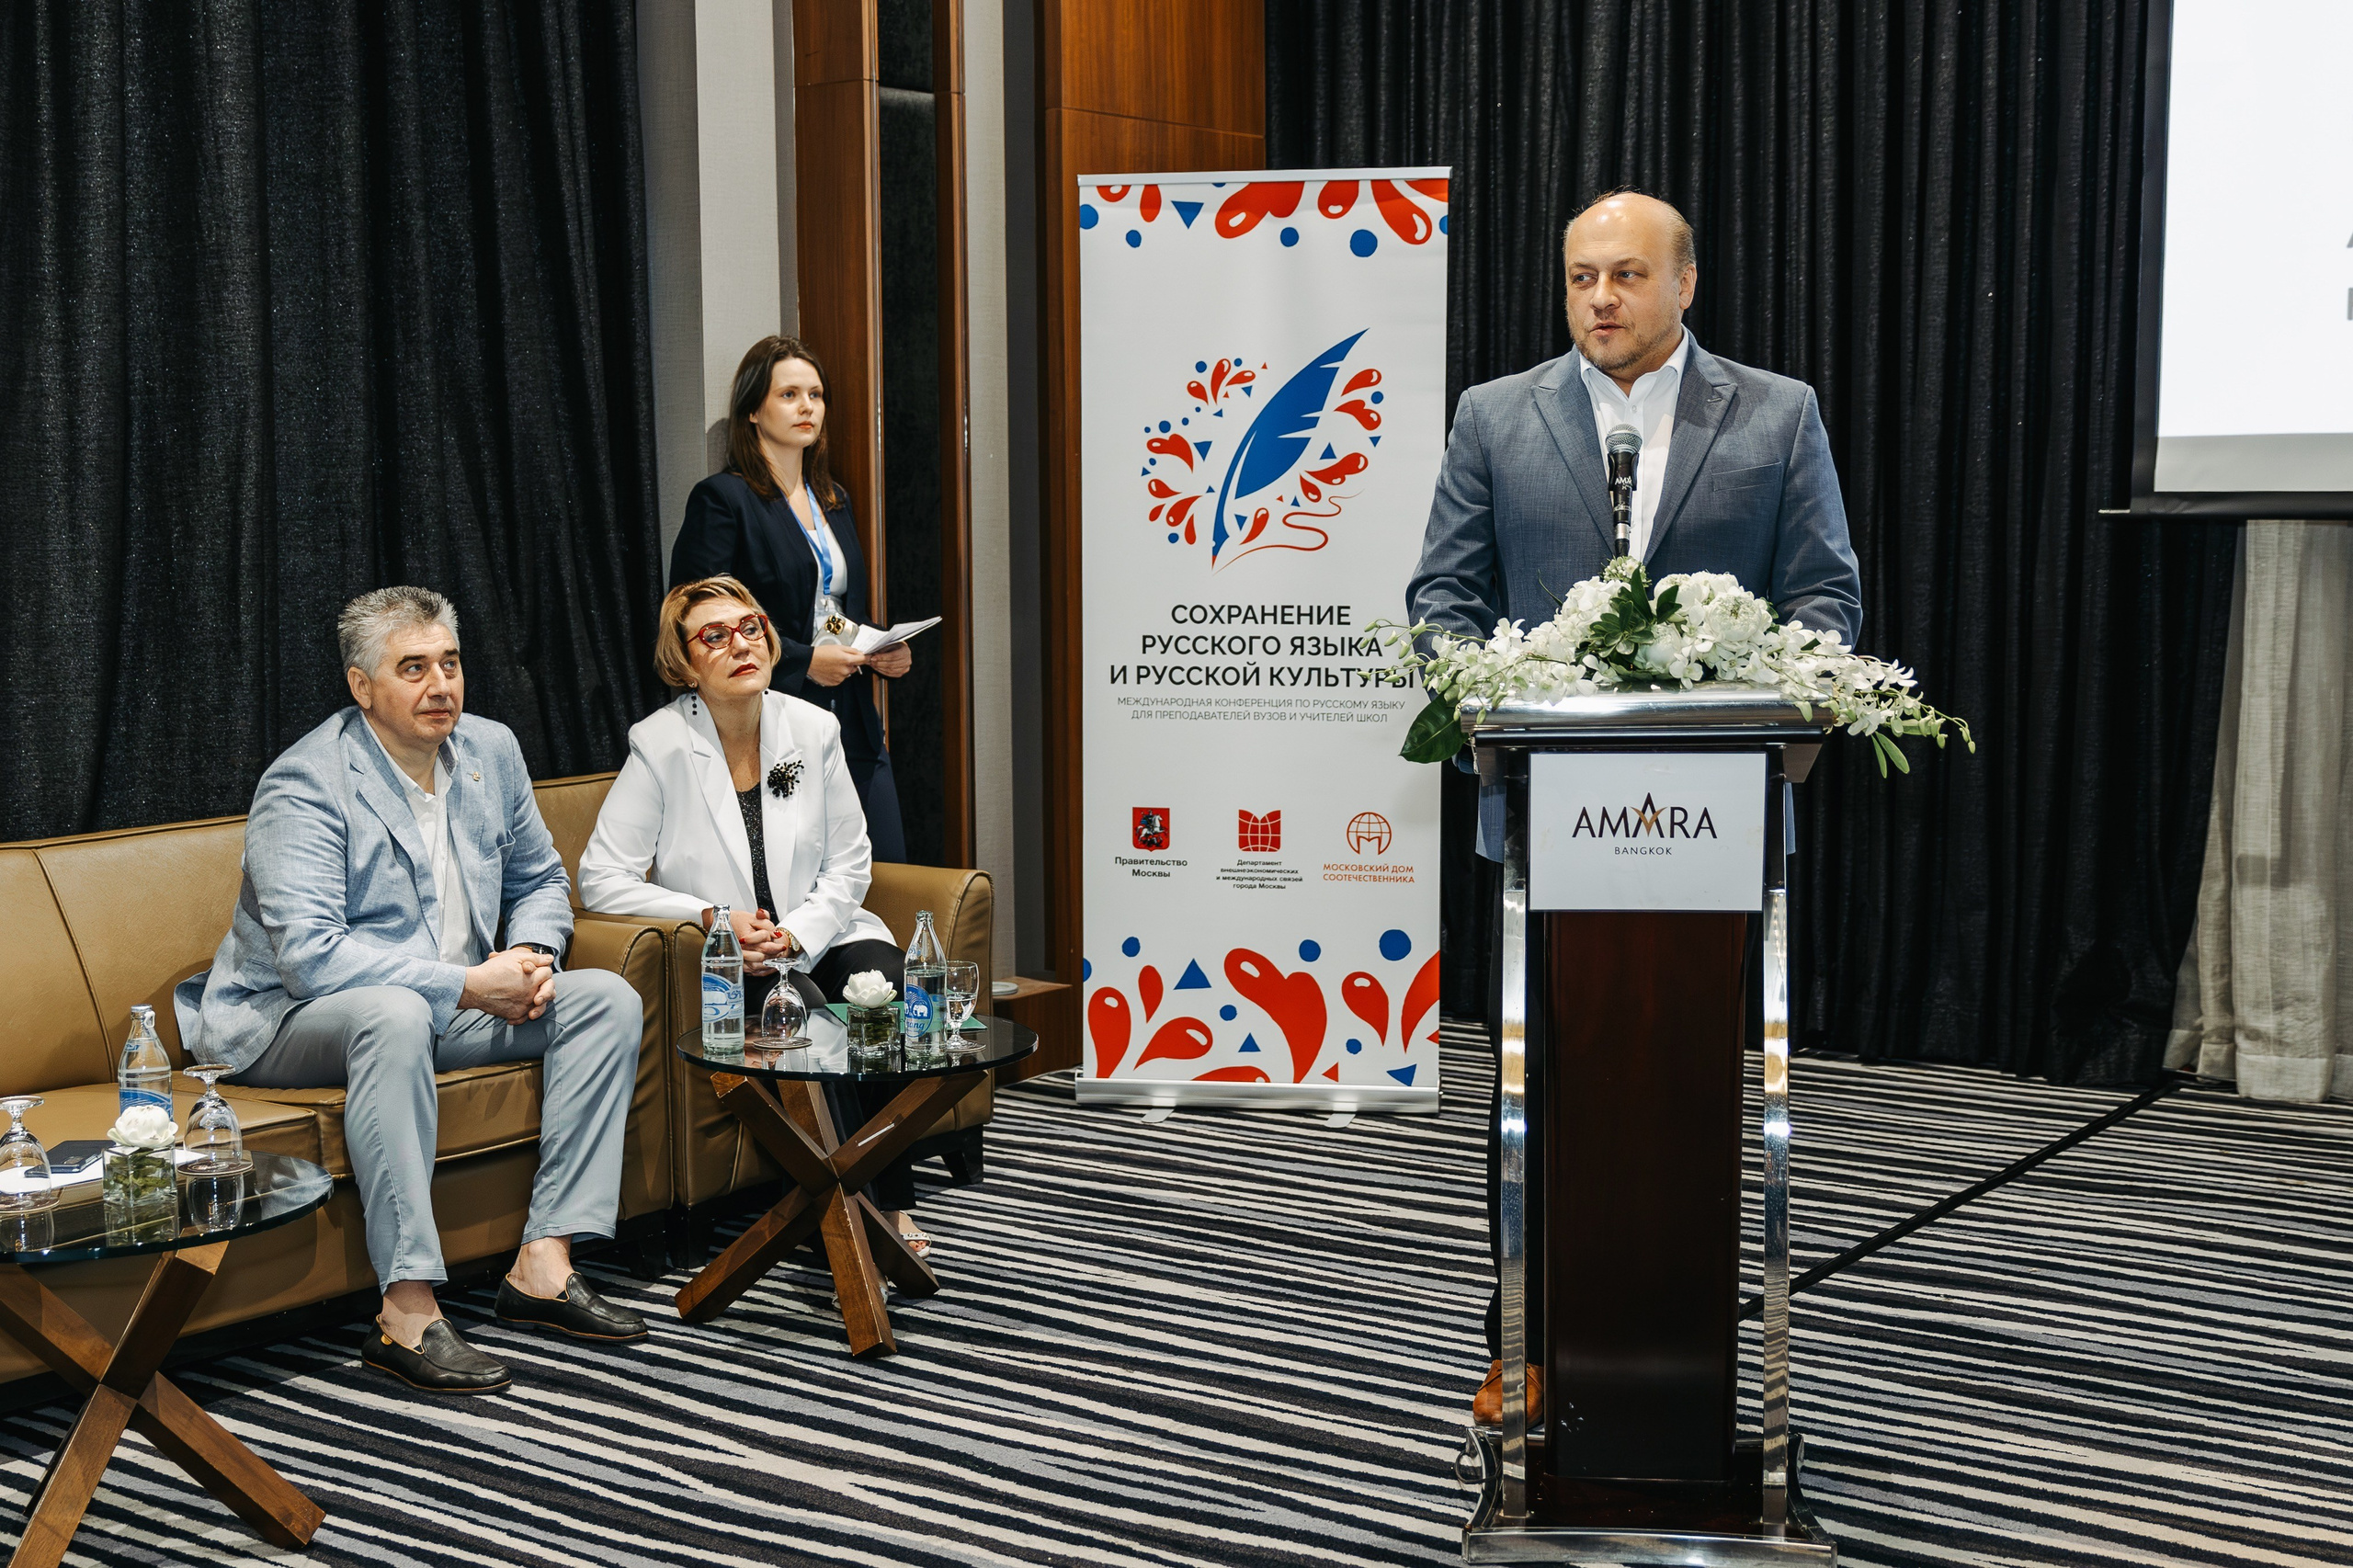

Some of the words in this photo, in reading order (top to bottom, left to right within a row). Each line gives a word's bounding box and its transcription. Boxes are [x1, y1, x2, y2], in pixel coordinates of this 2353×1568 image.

[1171, 604, 1351, 626] СОХРАНЕНИЕ
[1142, 634, 1281, 656] РУССКОГО
[1290, 635, 1383, 657] ЯЗЫКА
[1110, 665, 1128, 685] И
[1136, 661, 1260, 687] РУССКОЙ
[1117, 697, 1212, 708] МЕЖДУНАРОДНАЯ
[1214, 698, 1292, 709] КОНФЕРЕНЦИЯ
[1295, 699, 1311, 709] ПО
[1313, 699, 1370, 710] РУССКОМУ
[1370, 699, 1405, 710] ЯЗЫКУ
[1131, 710, 1153, 720] ДЛЯ
[1154, 710, 1251, 721] ПРЕПОДАВАТЕЛЕЙ
[1253, 711, 1287, 722] ВУЗОВ
[1289, 712, 1297, 721] И
[1299, 711, 1354, 722] УЧИТЕЛЕЙ
[1356, 713, 1388, 722] ШКОЛ
[1572, 792, 1718, 839] AMARA
[1614, 846, 1672, 856] BANGKOK
[1114, 856, 1188, 867] Правительство
[1236, 858, 1282, 867] Департамент
[1131, 869, 1171, 878] Москвы
[1323, 863, 1390, 873] МОСКОВСКИЙ
[1391, 865, 1415, 874] ДОМ
[1323, 872, 1415, 883] СООТЕЧЕСТВЕННИКА
